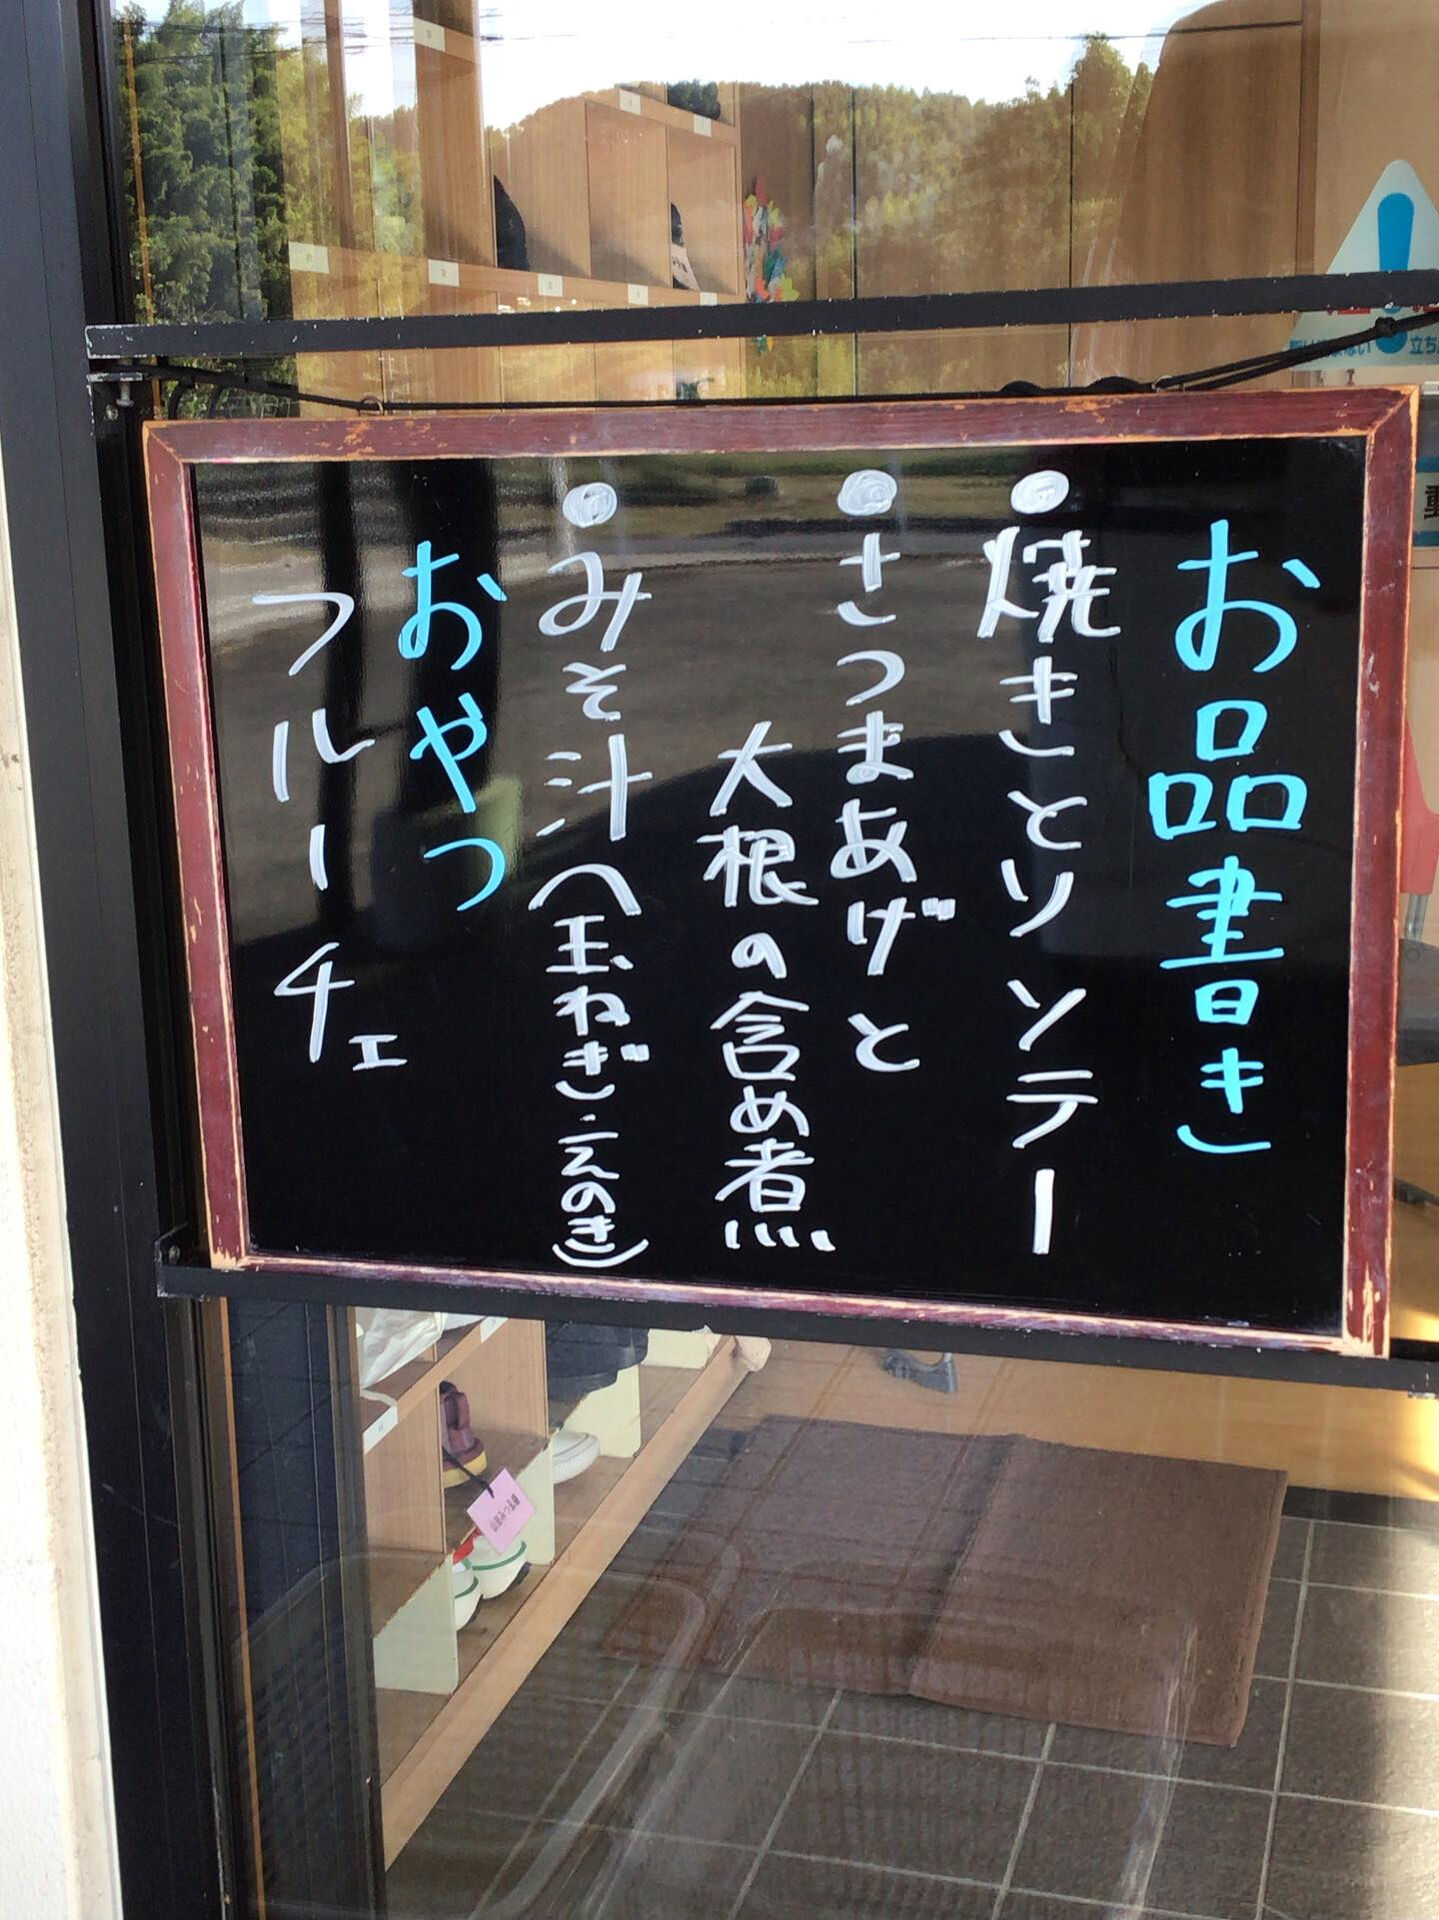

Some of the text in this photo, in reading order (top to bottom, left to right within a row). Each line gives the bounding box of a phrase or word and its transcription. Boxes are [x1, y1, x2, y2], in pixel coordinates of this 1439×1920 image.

[252, 592, 407, 1072] フルーチェ
[398, 540, 507, 911] おやつ
[697, 720, 836, 1252] 大根の含め煮
[830, 532, 956, 1072] さつまあげと
[1149, 519, 1321, 1154] お品書き
